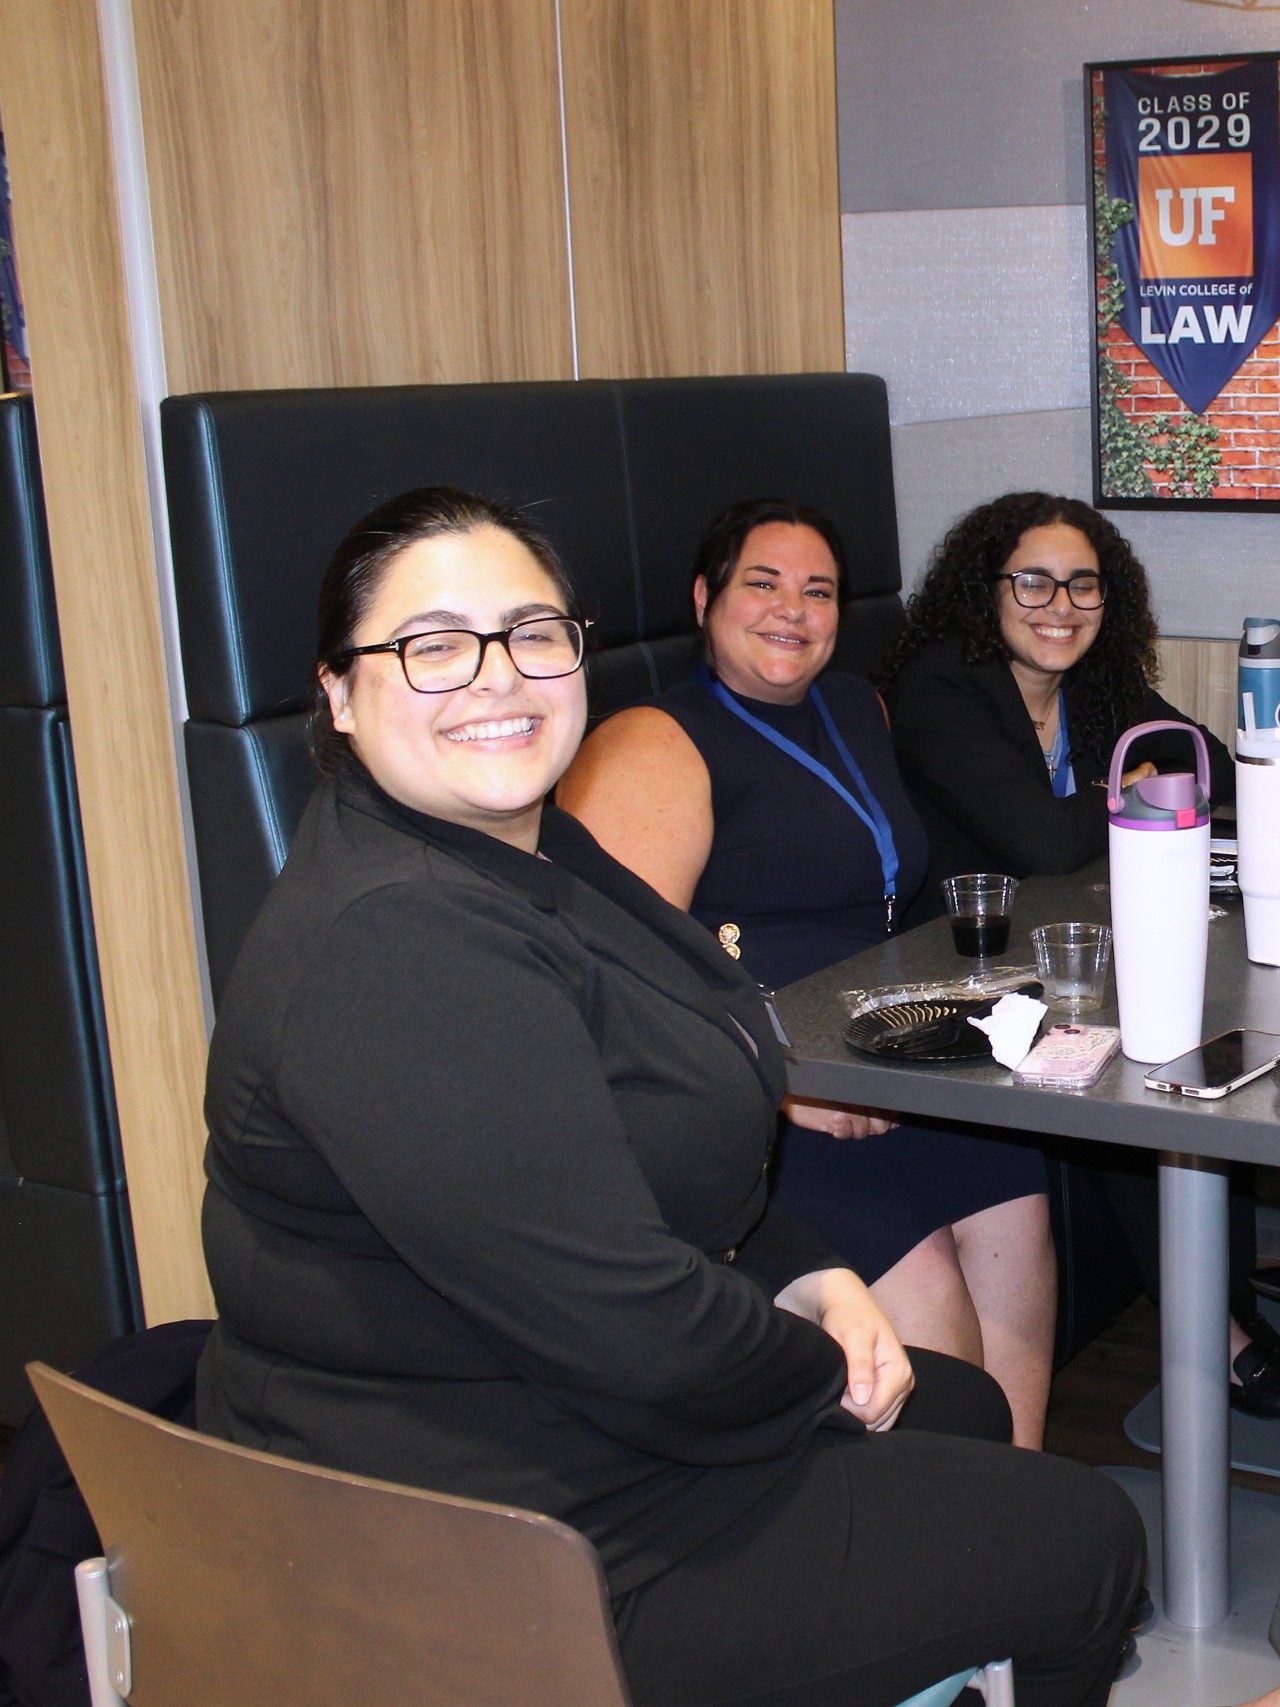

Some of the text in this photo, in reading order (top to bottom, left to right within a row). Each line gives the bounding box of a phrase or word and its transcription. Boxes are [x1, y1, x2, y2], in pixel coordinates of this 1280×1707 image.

[1138, 91, 1250, 114] CLASS OF
[1138, 113, 1251, 151] 2029
[1155, 186, 1235, 247] UF
[1140, 282, 1253, 297] LEVIN COLLEGE of
[1141, 305, 1252, 344] LAW
